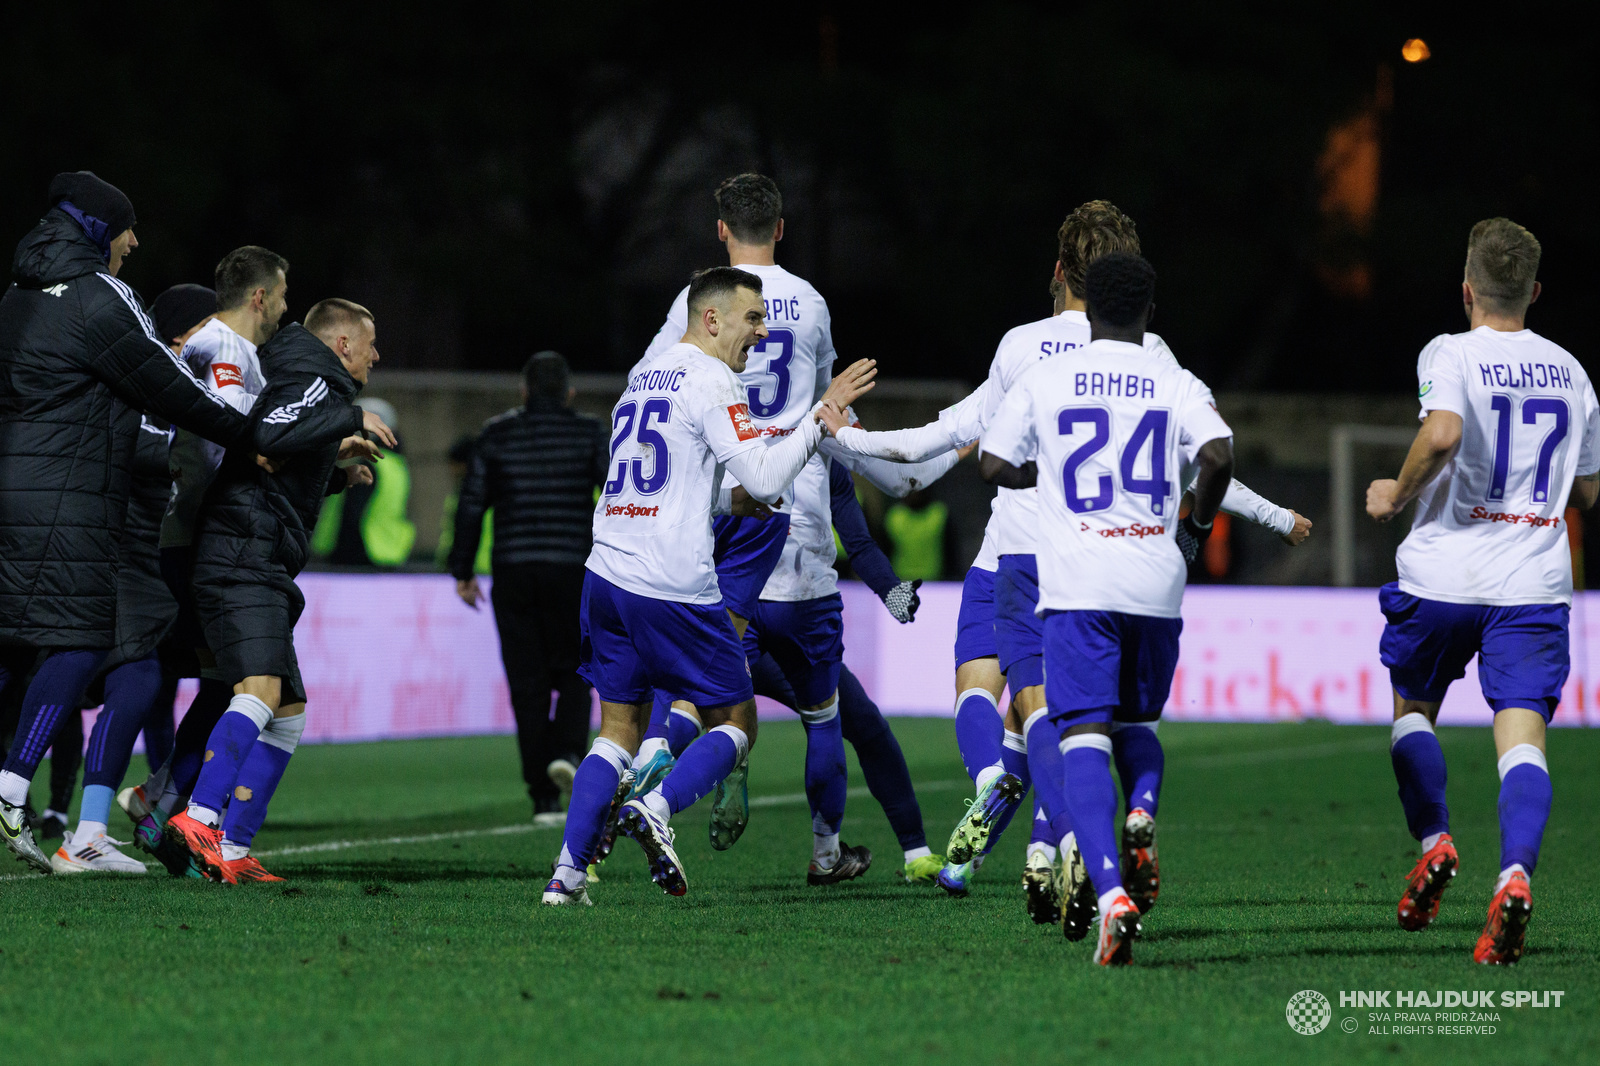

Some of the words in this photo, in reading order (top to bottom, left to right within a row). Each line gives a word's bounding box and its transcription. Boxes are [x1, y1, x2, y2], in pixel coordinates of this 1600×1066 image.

[764, 296, 800, 321] RPIĆ
[1075, 372, 1155, 398] BAMBA
[1479, 363, 1574, 390] MELNJAK
[605, 397, 673, 496] 25
[1486, 392, 1571, 506] 17
[1055, 404, 1172, 517] 24
[1470, 506, 1560, 528] SuperSport
